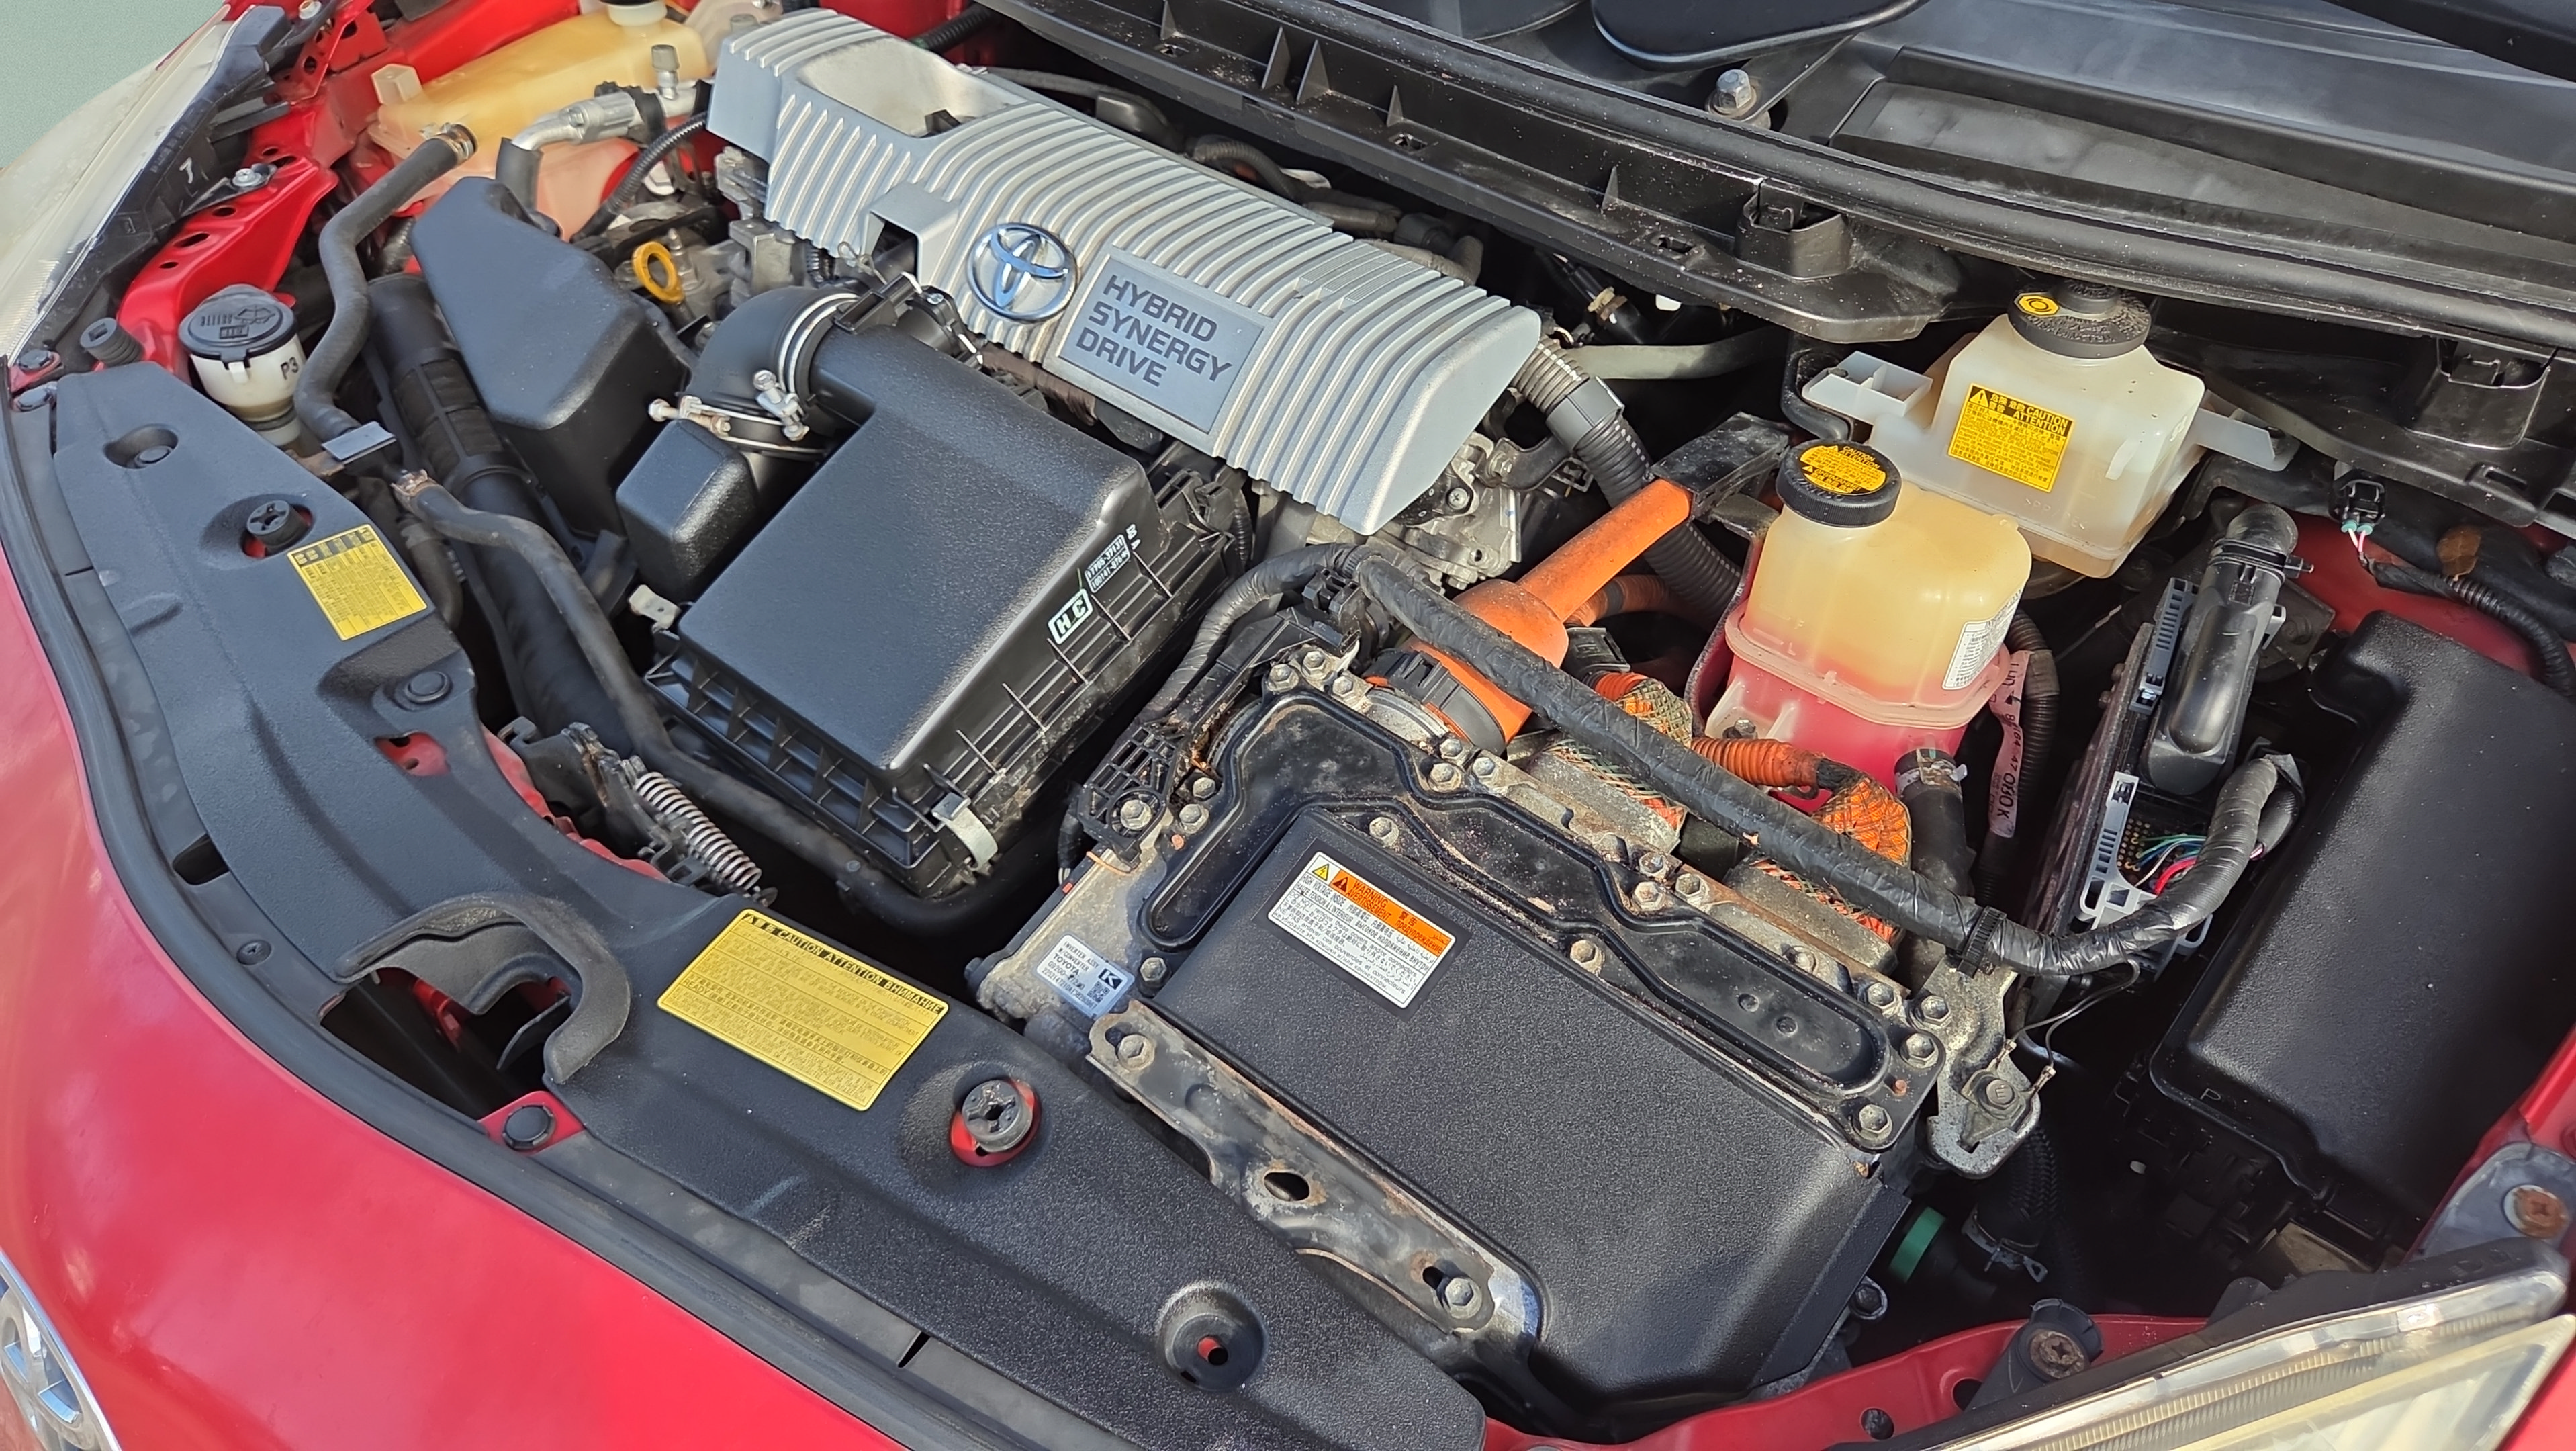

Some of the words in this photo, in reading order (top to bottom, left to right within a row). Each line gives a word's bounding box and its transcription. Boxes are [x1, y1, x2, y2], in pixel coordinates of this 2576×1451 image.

[1103, 275, 1217, 342] HYBRID
[1089, 300, 1233, 382] SYNERGY
[280, 357, 299, 380] P3
[1076, 327, 1167, 388] DRIVE
[2012, 409, 2065, 435] ATTENTION
[2025, 406, 2068, 427] CAUTION
[1840, 450, 1880, 469] ATTENTION
[1843, 446, 1875, 461] CAUTION
[1300, 873, 1315, 886] HIGH
[1312, 880, 1332, 897] VOLTAGE
[1308, 891, 1327, 906] TENSION
[1350, 880, 1389, 908] WARNING
[1345, 887, 1391, 921] AVERTISSEMENT
[1289, 890, 1300, 899] DO
[1299, 897, 1314, 909] NOT
[1314, 907, 1334, 922] remove
[1334, 920, 1350, 932] these
[1350, 930, 1369, 945] covers
[1369, 942, 1387, 957] and/or
[1063, 941, 1087, 959] INVERTER
[1288, 912, 1301, 924] PAS
[1300, 922, 1321, 937] enlever
[1322, 936, 1333, 945] ces
[1333, 943, 1363, 965] couvercles
[1354, 920, 1379, 938] высокое
[1375, 934, 1411, 961] напряжение
[1393, 919, 1444, 956] предупреждение
[776, 929, 825, 956] CAUTION
[823, 951, 884, 985] ATTENTION
[1052, 953, 1080, 976] TOYOTA
[1100, 969, 1121, 989] K
[882, 980, 944, 1014] ВНИМАНИЕ
[2200, 1088, 2221, 1100] P
